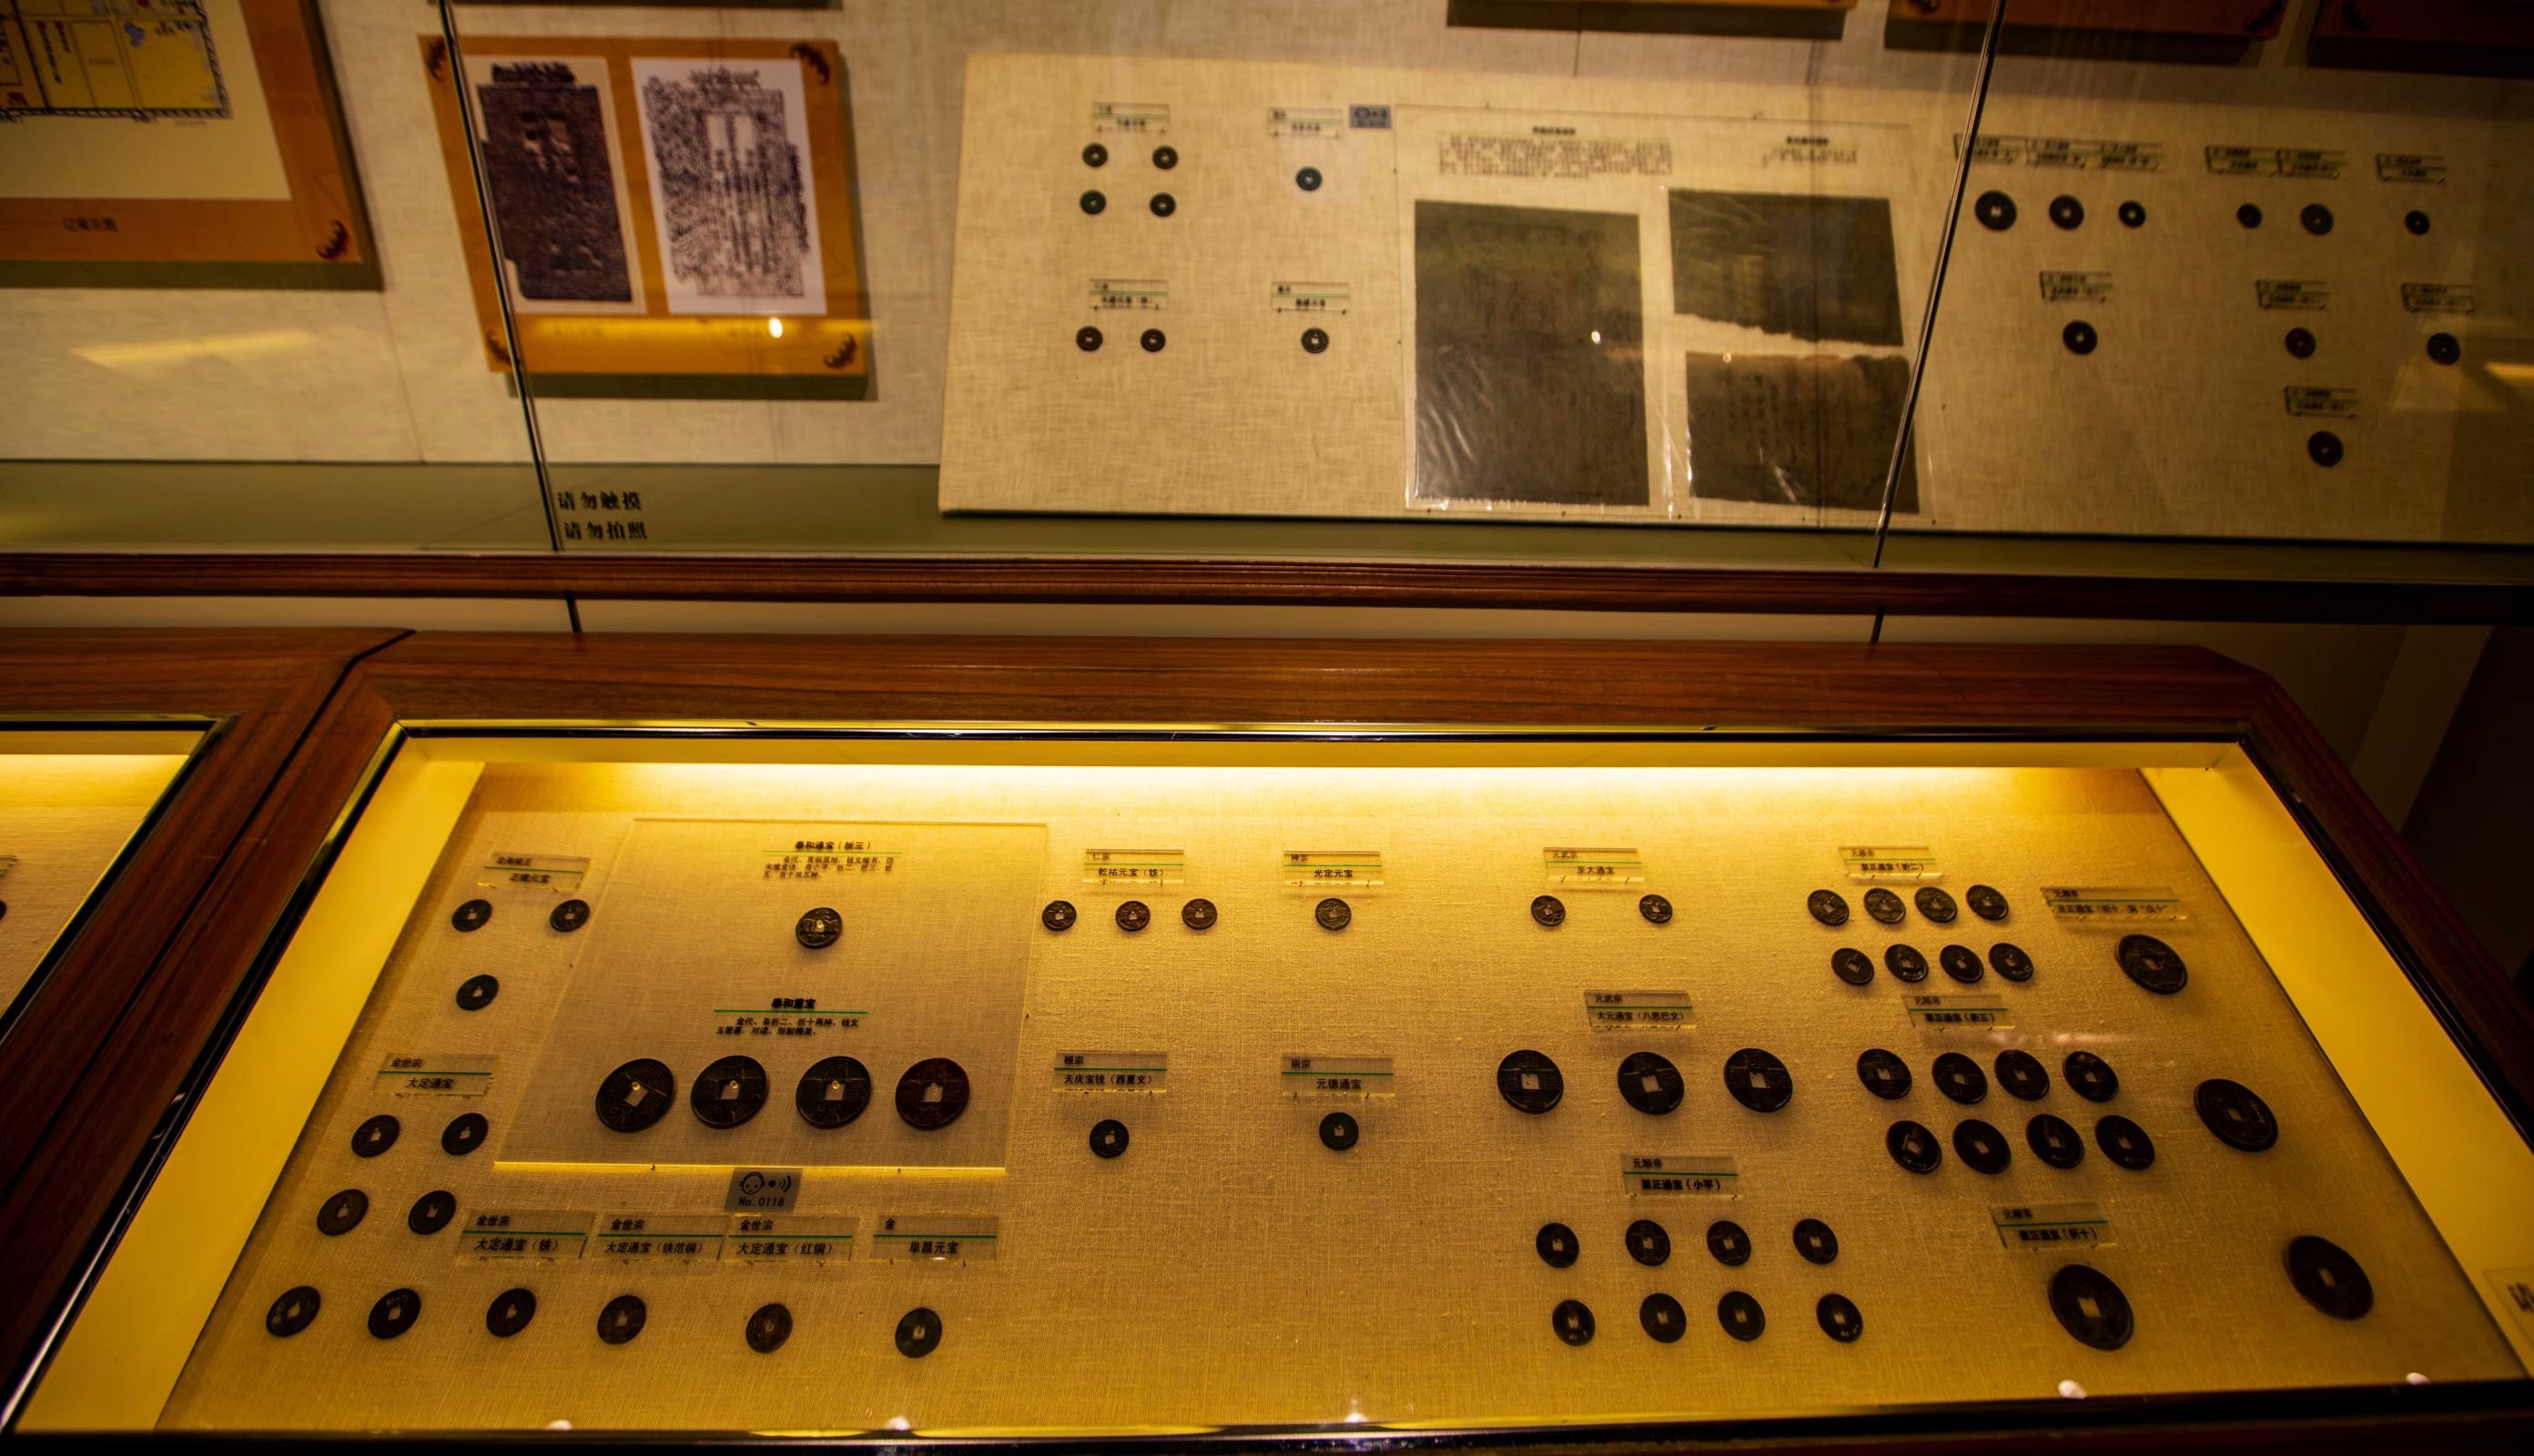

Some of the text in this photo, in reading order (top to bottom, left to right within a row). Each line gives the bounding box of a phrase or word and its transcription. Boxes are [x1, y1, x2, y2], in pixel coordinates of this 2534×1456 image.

[558, 491, 642, 510] 请勿触摸
[563, 521, 648, 539] 请勿拍照
[1313, 869, 1353, 878] 光定元宝
[391, 1057, 423, 1067] 金世宗
[406, 1077, 454, 1089] 大定通宝
[1064, 1074, 1152, 1085] 天庆宝钱（西夏文）
[1316, 1077, 1363, 1089] 元德通宝
[738, 1197, 785, 1207] No. 0118
[476, 1214, 511, 1226] 金世宗
[610, 1218, 644, 1230] 金世宗
[739, 1219, 774, 1230] 金世宗
[885, 1218, 896, 1229] 金
[474, 1238, 558, 1252] 大定通宝（铁）
[604, 1241, 703, 1254] 大定通宝（铁范铜）
[736, 1242, 833, 1255] 大定通宝（红铜）
[908, 1240, 959, 1254] 阜昌元宝
